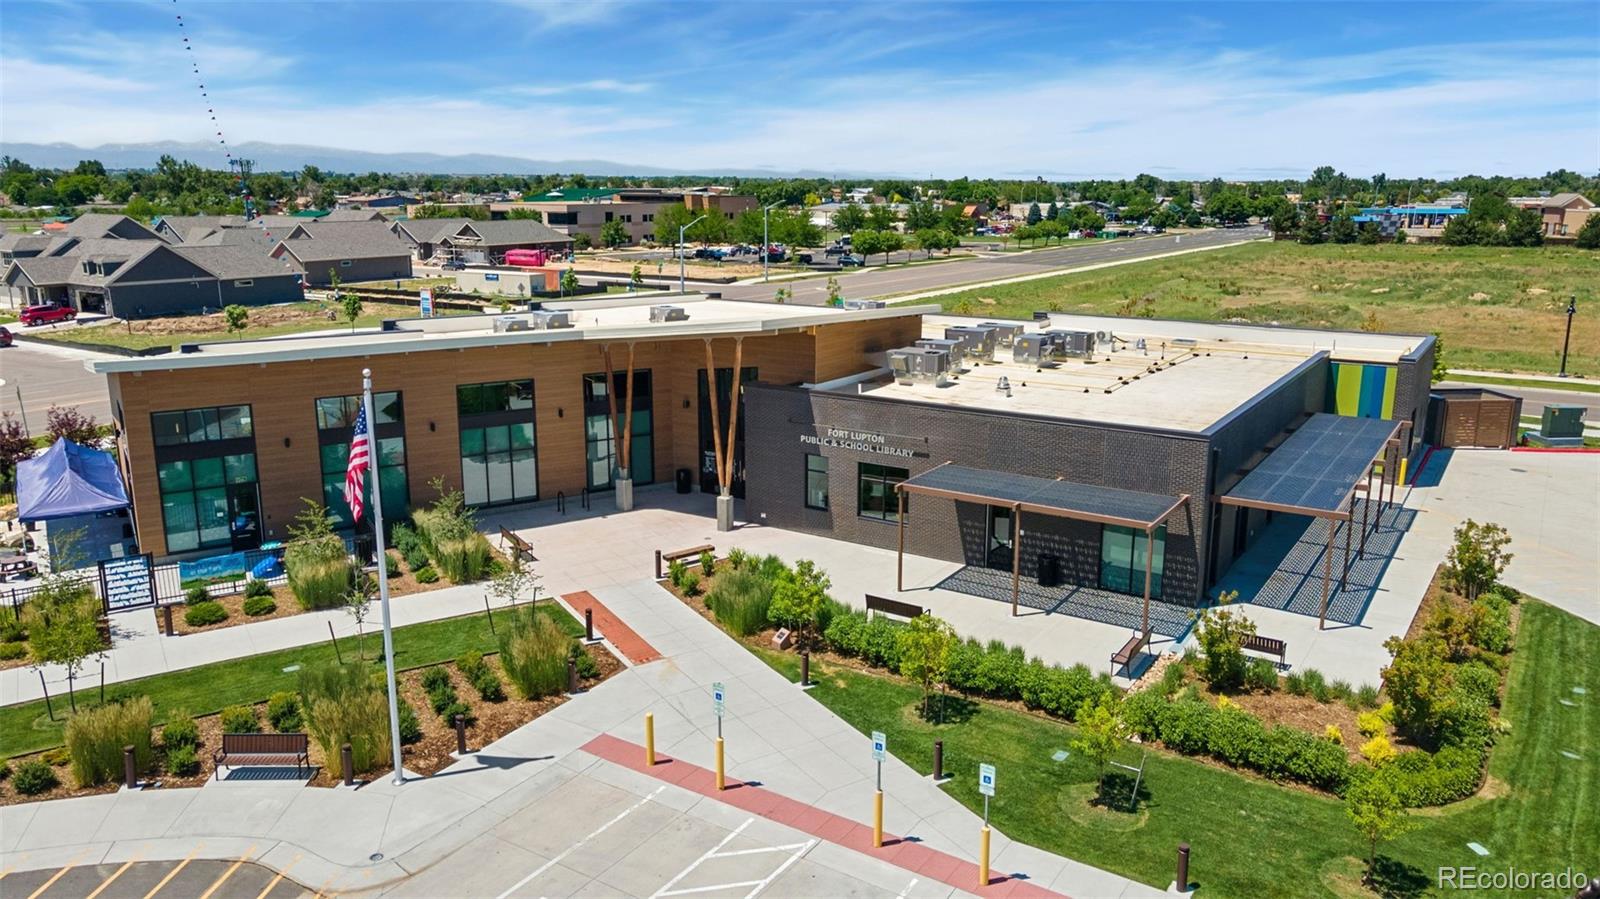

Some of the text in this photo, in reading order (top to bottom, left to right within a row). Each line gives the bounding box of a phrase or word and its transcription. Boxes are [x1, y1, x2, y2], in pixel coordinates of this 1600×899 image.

[828, 428, 885, 444] FORT LUPTON
[800, 435, 914, 458] PUBLIC & SCHOOL LIBRARY
